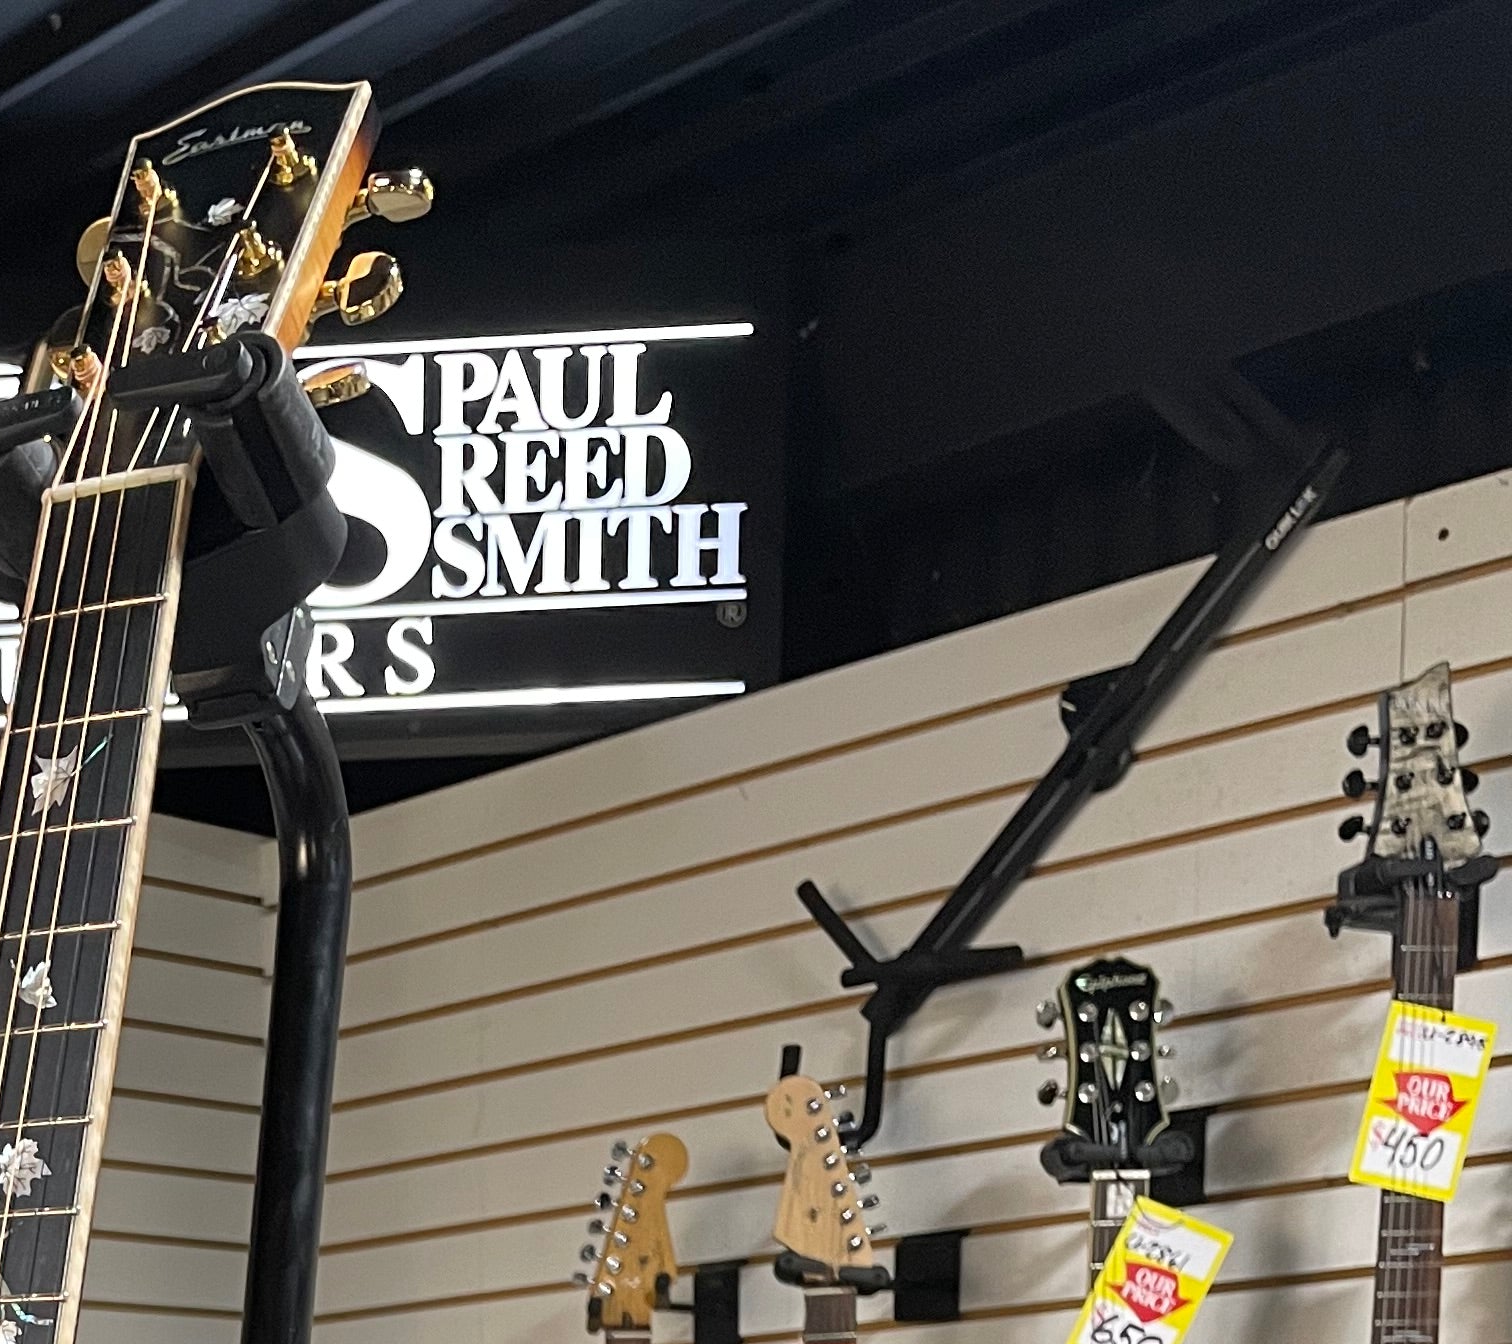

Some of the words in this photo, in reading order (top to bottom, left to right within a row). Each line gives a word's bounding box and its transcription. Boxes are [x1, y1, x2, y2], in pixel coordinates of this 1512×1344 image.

[433, 342, 673, 436] PAUL
[433, 424, 692, 518] REED
[432, 502, 748, 598] SMITH
[1397, 1091, 1453, 1121] PRICE
[1406, 1076, 1450, 1103] OUR
[1121, 1279, 1177, 1314] PRICE
[1135, 1267, 1177, 1297] OUR
